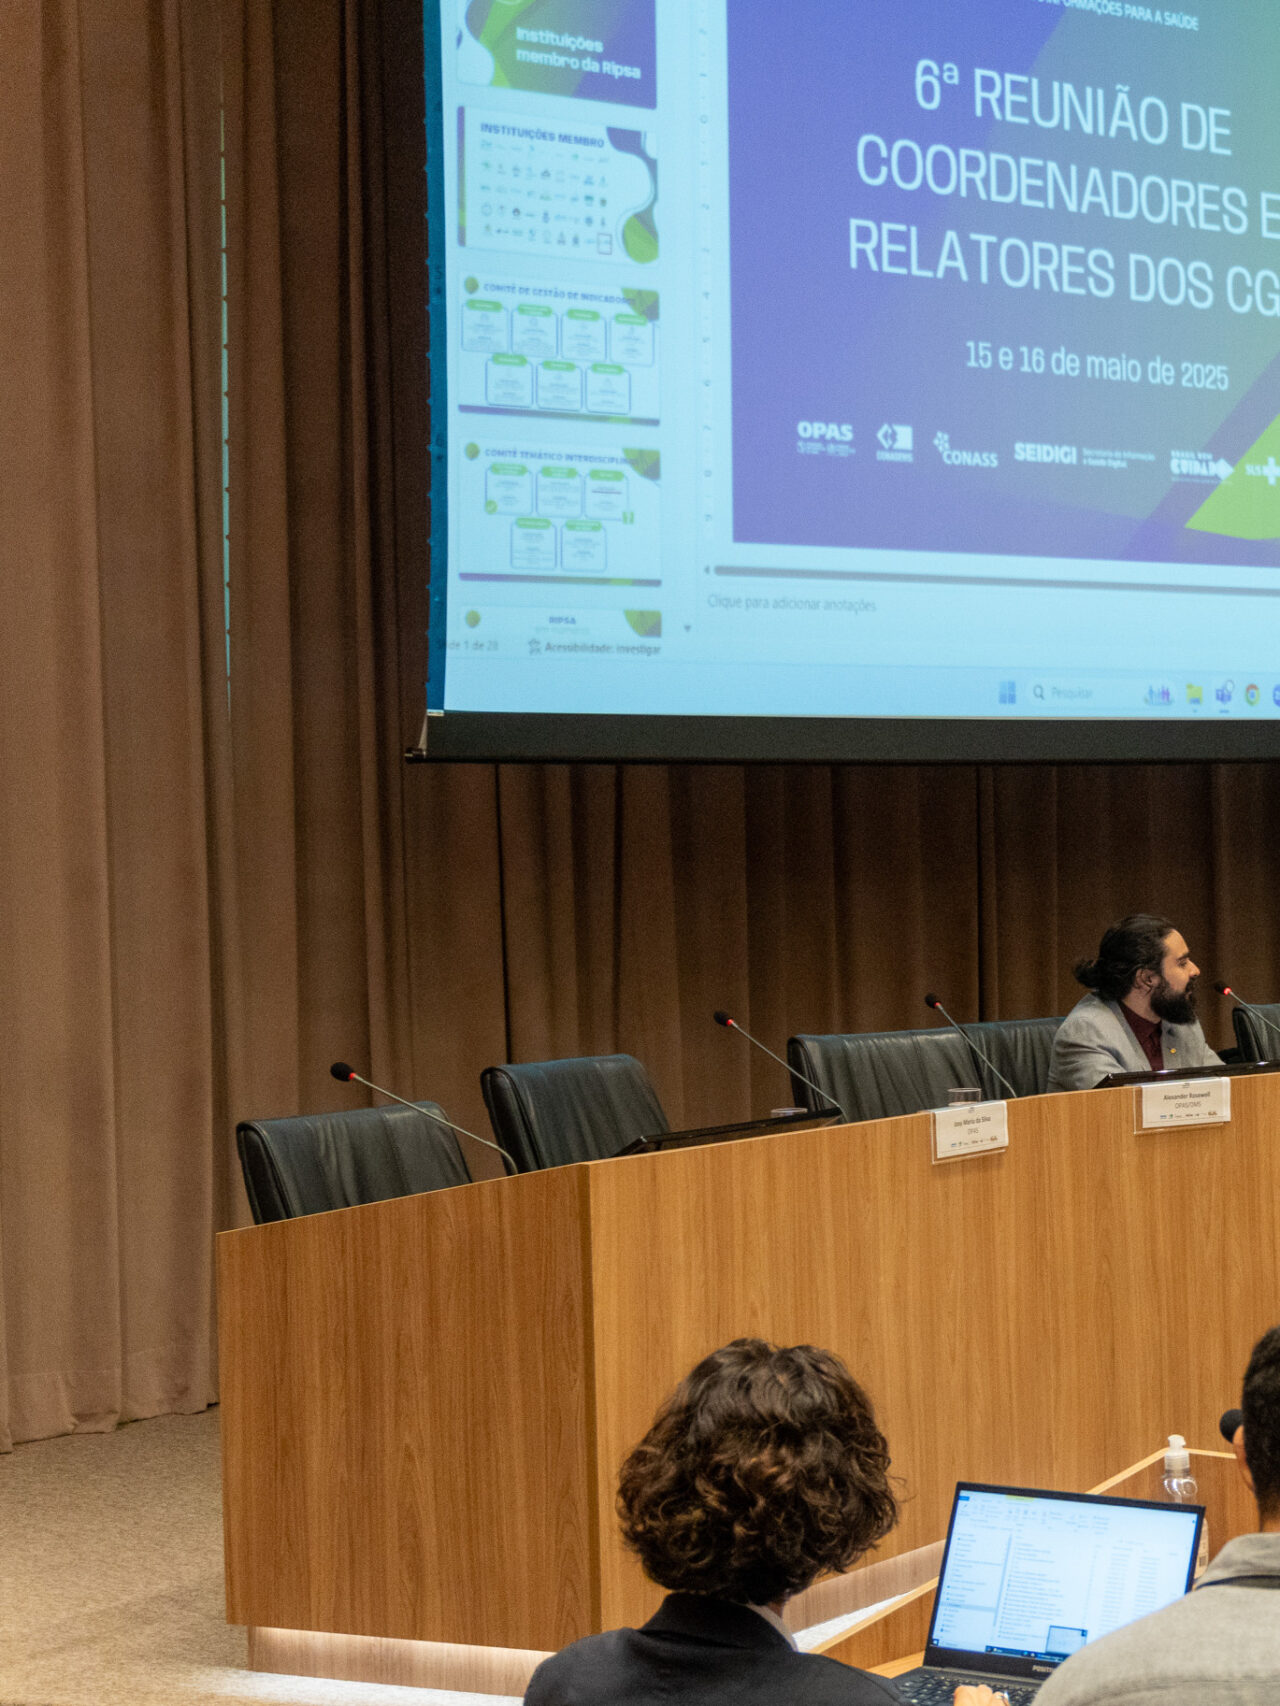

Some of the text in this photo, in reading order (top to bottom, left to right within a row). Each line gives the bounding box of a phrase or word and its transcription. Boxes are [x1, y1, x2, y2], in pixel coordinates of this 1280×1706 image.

[1124, 4, 1153, 22] PARA
[1154, 9, 1163, 24] A
[1164, 11, 1199, 31] SAÚDE
[516, 27, 604, 53] Instituições
[516, 49, 641, 80] membro da Ripsa
[915, 58, 1232, 155] 6ª REUNIÃO DE
[480, 122, 605, 148] INSTITUIÇÕES MEMBRO
[857, 134, 1248, 235] COORDENADORES
[849, 218, 1115, 298] RELATORES
[1129, 253, 1213, 310] DOS
[965, 340, 1229, 391] 15 e 16 de maio de 2025
[797, 421, 853, 441] OPAS
[942, 450, 998, 468] CONASS
[1014, 442, 1077, 464] SEIDIGI
[708, 595, 877, 614] Clique para adicionar anotações
